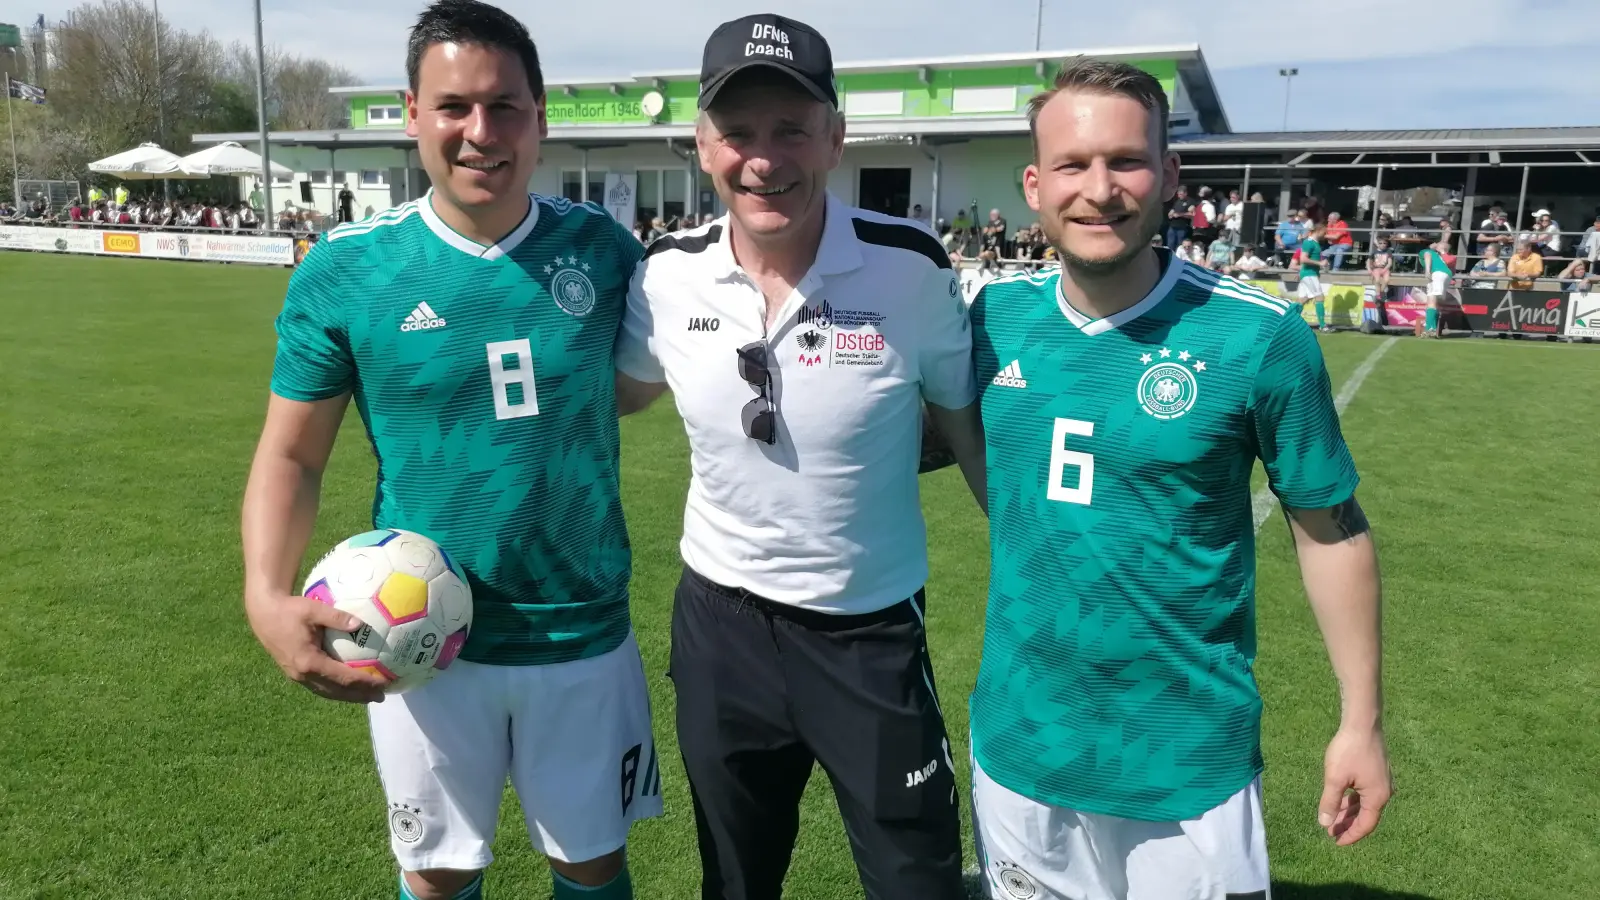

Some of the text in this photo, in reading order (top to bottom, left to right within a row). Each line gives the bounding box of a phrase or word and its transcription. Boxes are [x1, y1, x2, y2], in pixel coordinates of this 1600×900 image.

[752, 23, 790, 44] DFNB
[745, 42, 794, 61] Coach
[546, 102, 640, 118] chnelldorf 1946
[156, 239, 175, 251] NWS
[206, 240, 245, 251] Nahwärme
[247, 242, 291, 255] Schnelldorf
[1492, 290, 1561, 330] Anna
[400, 316, 446, 332] adidas
[687, 317, 720, 332] JAKO
[844, 319, 881, 327] BÜRGERMSTER
[836, 332, 885, 351] DStGB
[835, 351, 861, 359] Deutscher
[486, 338, 540, 420] 8
[993, 375, 1027, 389] adidas
[1153, 369, 1187, 383] DEUTSCHER
[1046, 417, 1095, 505] 6
[357, 623, 373, 649] SELECT
[620, 742, 642, 818] 8
[905, 759, 938, 788] JAKO
